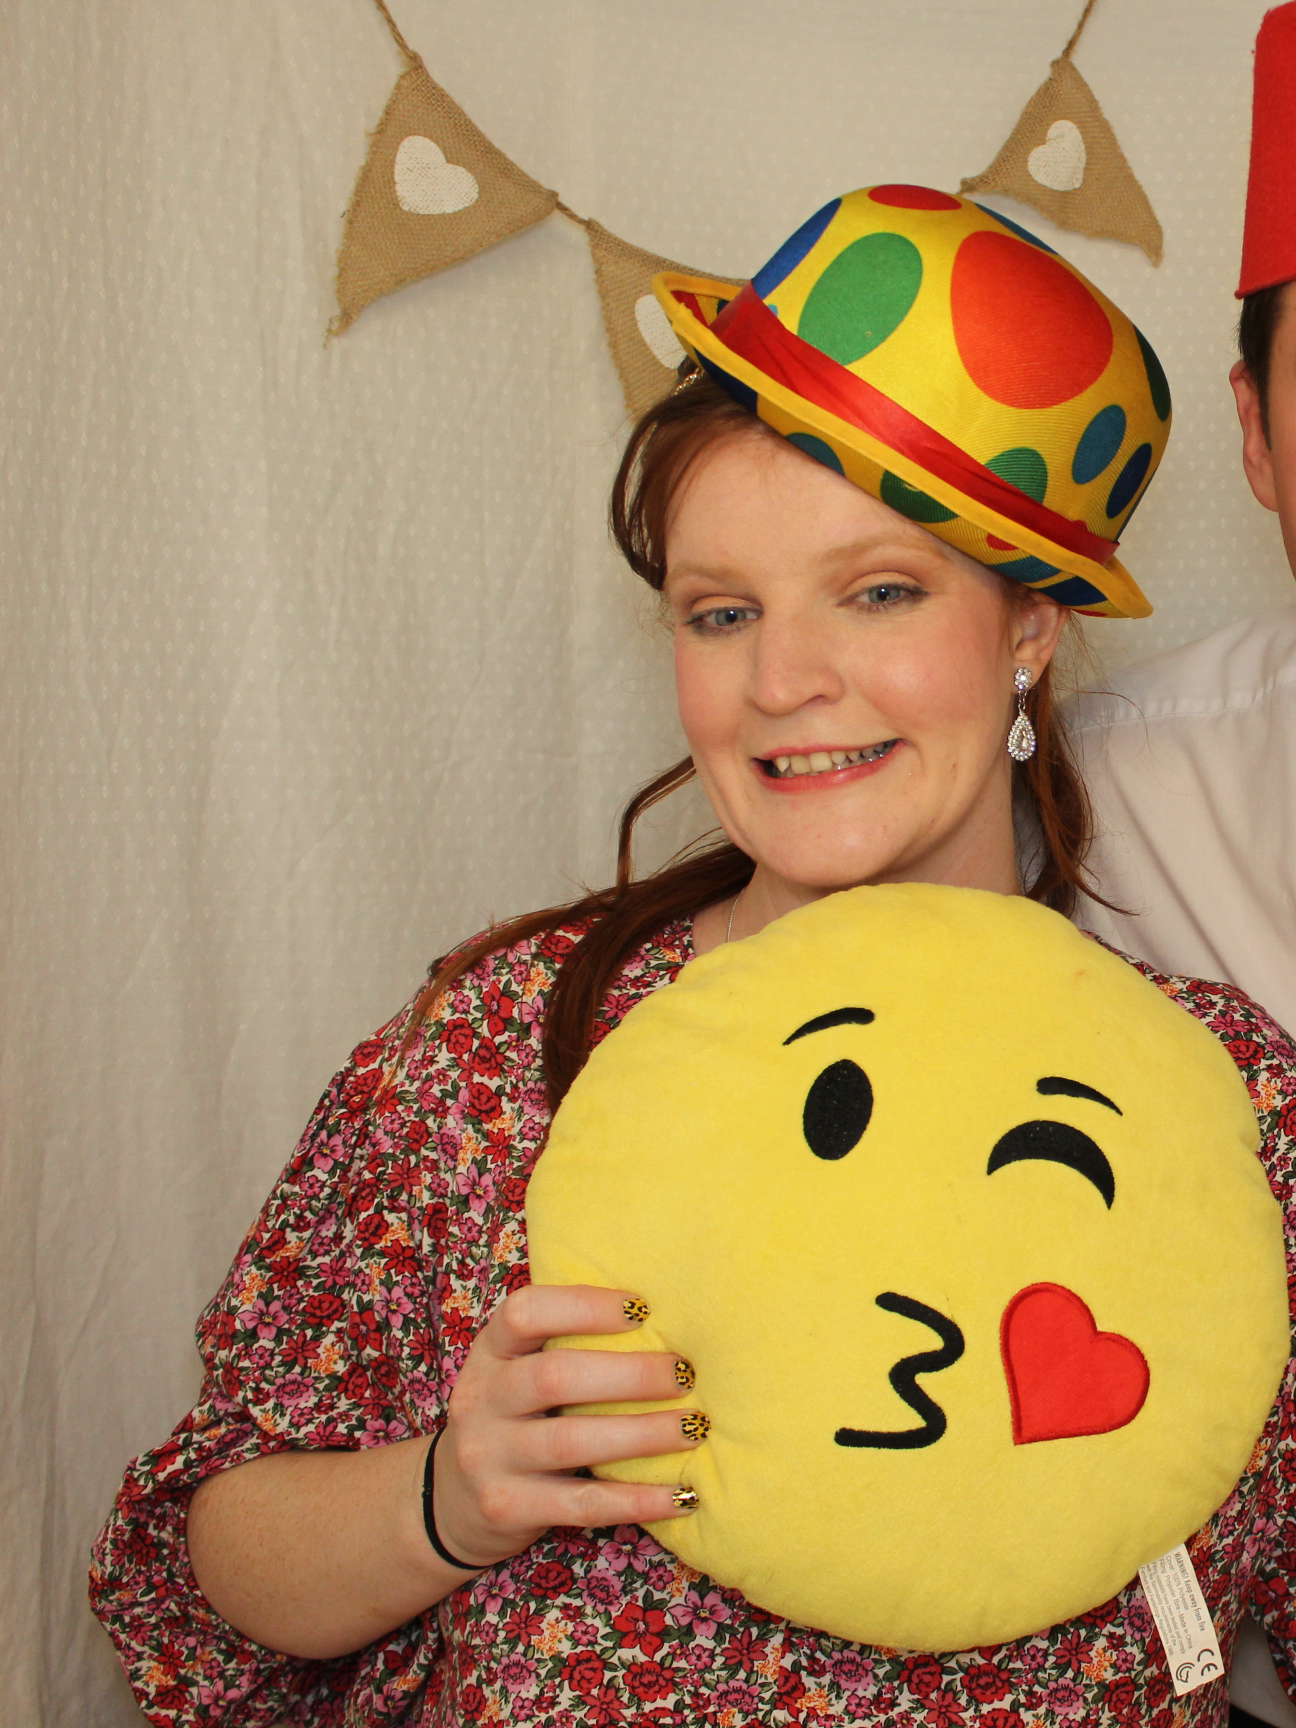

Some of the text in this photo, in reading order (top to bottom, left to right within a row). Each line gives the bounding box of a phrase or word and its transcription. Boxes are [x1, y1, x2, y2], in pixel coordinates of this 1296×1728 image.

[1159, 1558, 1167, 1574] Filling:
[1164, 1574, 1177, 1599] Polyester
[1173, 1598, 1181, 1610] fibre
[1179, 1613, 1187, 1628] Made
[1185, 1633, 1193, 1649] China
[1165, 1555, 1189, 1611] Cover: 100% Polyester
[1174, 1552, 1189, 1579] WARNING!
[1184, 1579, 1193, 1594] Keep
[1189, 1593, 1197, 1609] away
[1194, 1607, 1202, 1621] from
[1166, 1604, 1174, 1616] been
[1171, 1616, 1179, 1630] tested
[1178, 1639, 1186, 1655] comply
[1197, 1648, 1218, 1677] CE
